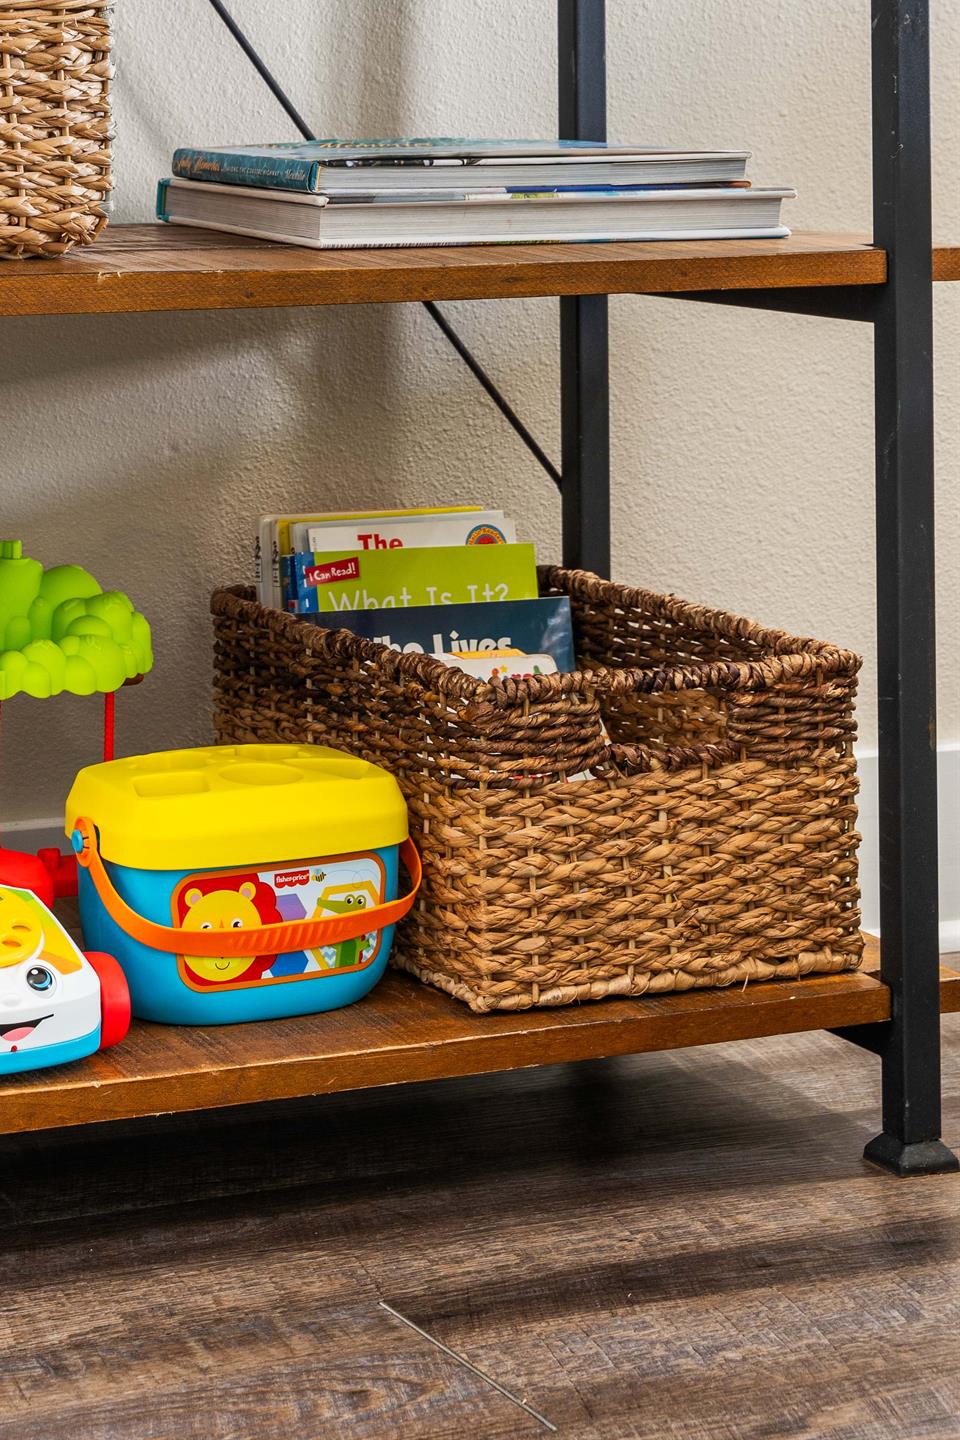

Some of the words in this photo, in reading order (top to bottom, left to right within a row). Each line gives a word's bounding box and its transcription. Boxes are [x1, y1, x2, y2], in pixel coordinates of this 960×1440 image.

[357, 534, 404, 551] The
[309, 573, 314, 582] I
[314, 569, 331, 581] Can
[331, 562, 356, 578] Read!
[328, 586, 412, 611] What
[426, 586, 453, 606] Is
[467, 583, 509, 603] It?
[368, 635, 425, 654] ho
[432, 630, 512, 653] Lives
